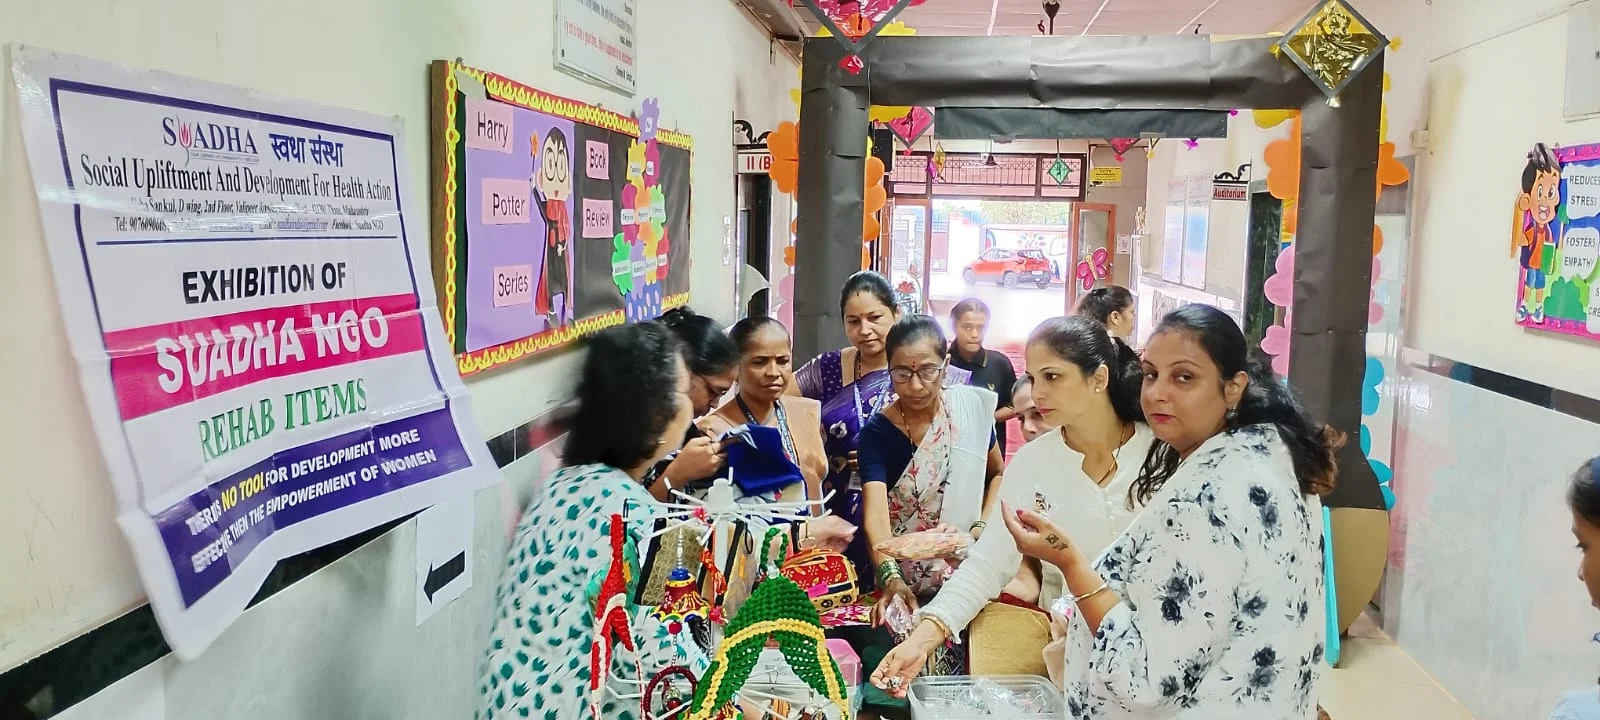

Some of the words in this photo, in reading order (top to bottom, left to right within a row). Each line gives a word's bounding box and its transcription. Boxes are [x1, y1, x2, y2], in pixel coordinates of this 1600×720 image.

[477, 111, 508, 148] Harry
[268, 133, 306, 163] स्वधा
[308, 134, 344, 167] संस्था
[590, 148, 607, 169] Book
[81, 153, 128, 187] Social
[132, 158, 212, 197] Upliftment
[216, 164, 241, 193] And
[243, 166, 311, 201] Development
[312, 172, 330, 197] For
[331, 174, 364, 199] Health
[366, 178, 392, 201] Action
[493, 193, 525, 217] Potter
[1213, 187, 1246, 199] Auditorium
[1571, 195, 1597, 206] STRESS
[149, 198, 177, 214] Sankul,
[179, 198, 185, 213] D
[186, 199, 203, 216] wing,
[204, 200, 216, 213] 2nd
[217, 200, 234, 214] Floor,
[586, 208, 610, 227] Review
[114, 216, 128, 232] Tel:
[1566, 237, 1596, 248] FOSTERS
[183, 263, 315, 304] EXHIBITION
[321, 262, 346, 289] OF
[498, 272, 528, 296] Series
[156, 317, 306, 394] SUADHA
[311, 306, 389, 358] NGO
[198, 398, 275, 463] REHAB
[285, 378, 367, 430] ITEMS
[221, 485, 237, 512] NO
[239, 471, 266, 501] TOOL
[265, 466, 288, 488] FOR
[291, 440, 375, 479] DEVELOPMENT
[380, 429, 420, 451] MORE
[229, 514, 249, 542] THEN
[249, 504, 265, 526] THE
[266, 471, 357, 516] EMPOWERMENT
[361, 464, 379, 481] OF
[382, 449, 437, 476] WOMEN
